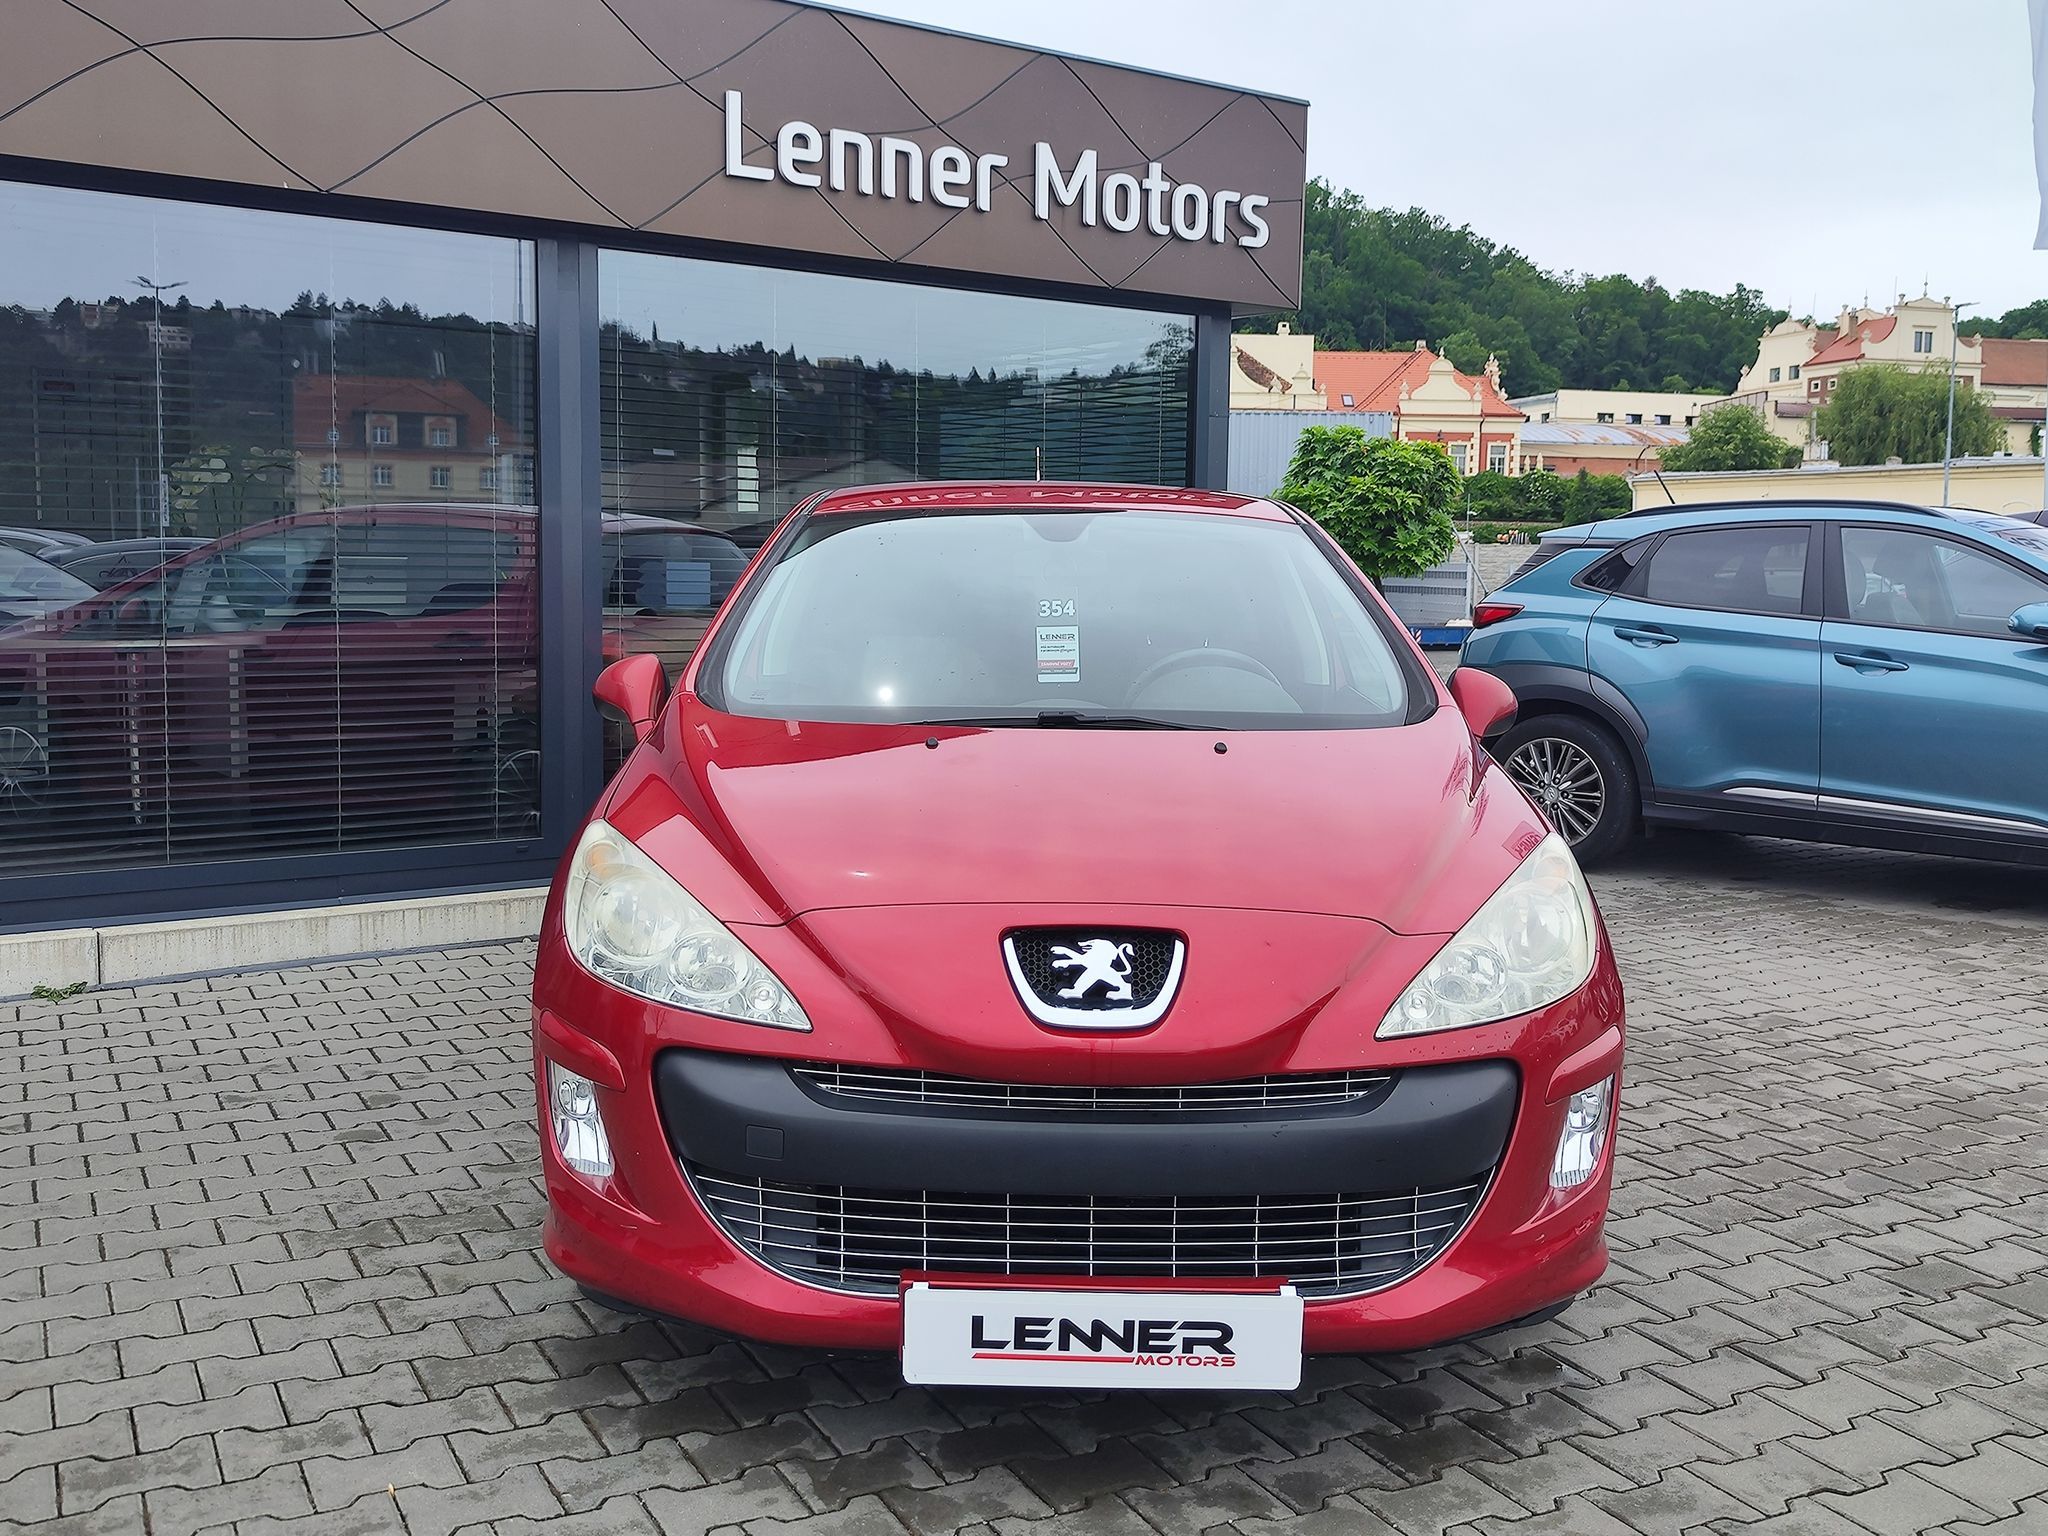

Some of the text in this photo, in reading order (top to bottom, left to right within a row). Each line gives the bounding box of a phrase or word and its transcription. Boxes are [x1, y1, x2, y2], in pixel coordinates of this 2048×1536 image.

[725, 90, 1270, 249] Lenner Motors
[1039, 599, 1076, 618] 354
[1040, 633, 1076, 641] LENNER
[971, 1315, 1236, 1355] LENNER
[1134, 1354, 1236, 1367] MOTORS
